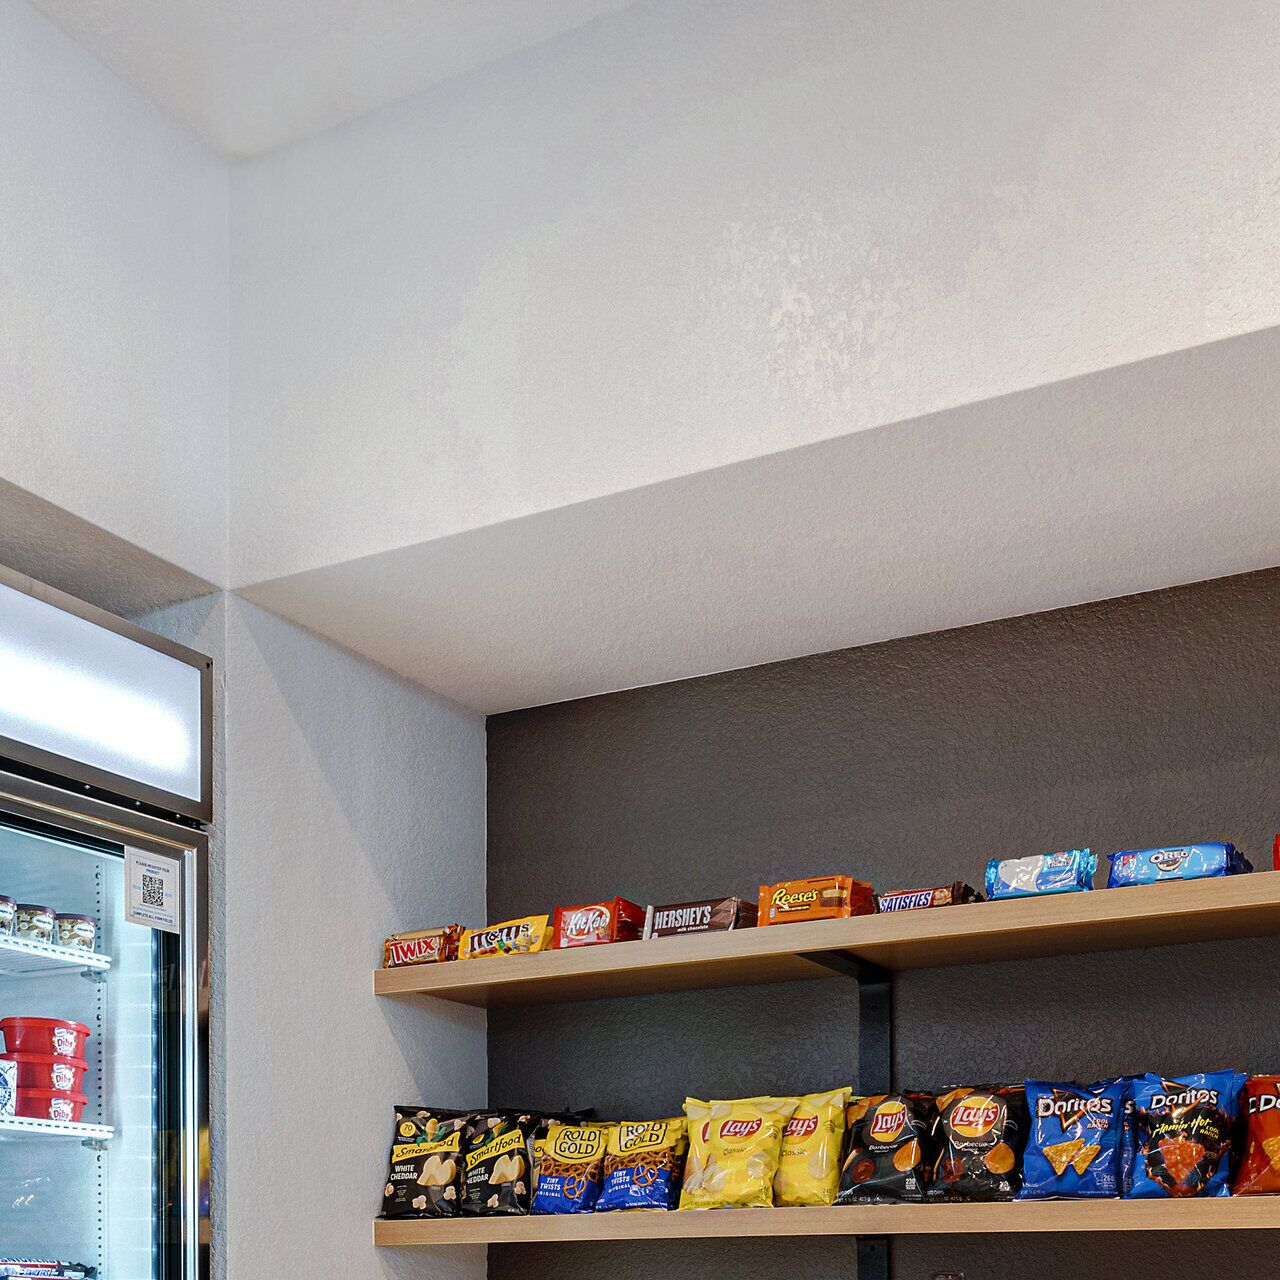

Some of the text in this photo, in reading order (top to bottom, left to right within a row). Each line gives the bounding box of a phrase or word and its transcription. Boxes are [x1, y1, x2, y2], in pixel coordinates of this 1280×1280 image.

[771, 888, 818, 907] Reese's
[880, 891, 932, 912] SATISFIES
[654, 904, 712, 930] HERSHEY'S
[1150, 1089, 1219, 1110] Doritos
[1036, 1097, 1112, 1117] Doritos
[874, 1108, 905, 1135] Lay's
[953, 1104, 999, 1128] Lay's
[626, 1122, 662, 1137] ROLD
[721, 1117, 762, 1137] Lay's
[1200, 1128, 1219, 1139] RANCH
[1205, 1124, 1220, 1133] COOL
[563, 1130, 596, 1143] ROLD
[624, 1132, 660, 1150] GOLD
[471, 1134, 521, 1166] Smartfood
[559, 1141, 595, 1155] GOLD
[954, 1140, 988, 1148] Barbecue
[395, 1164, 415, 1173] WHITE
[468, 1167, 486, 1178] WHITE
[613, 1169, 628, 1178] TINY
[390, 1171, 418, 1181] CHEDDAR
[546, 1176, 560, 1184] TINY
[611, 1175, 631, 1185] TWISTS
[540, 1182, 562, 1191] TWISTS
